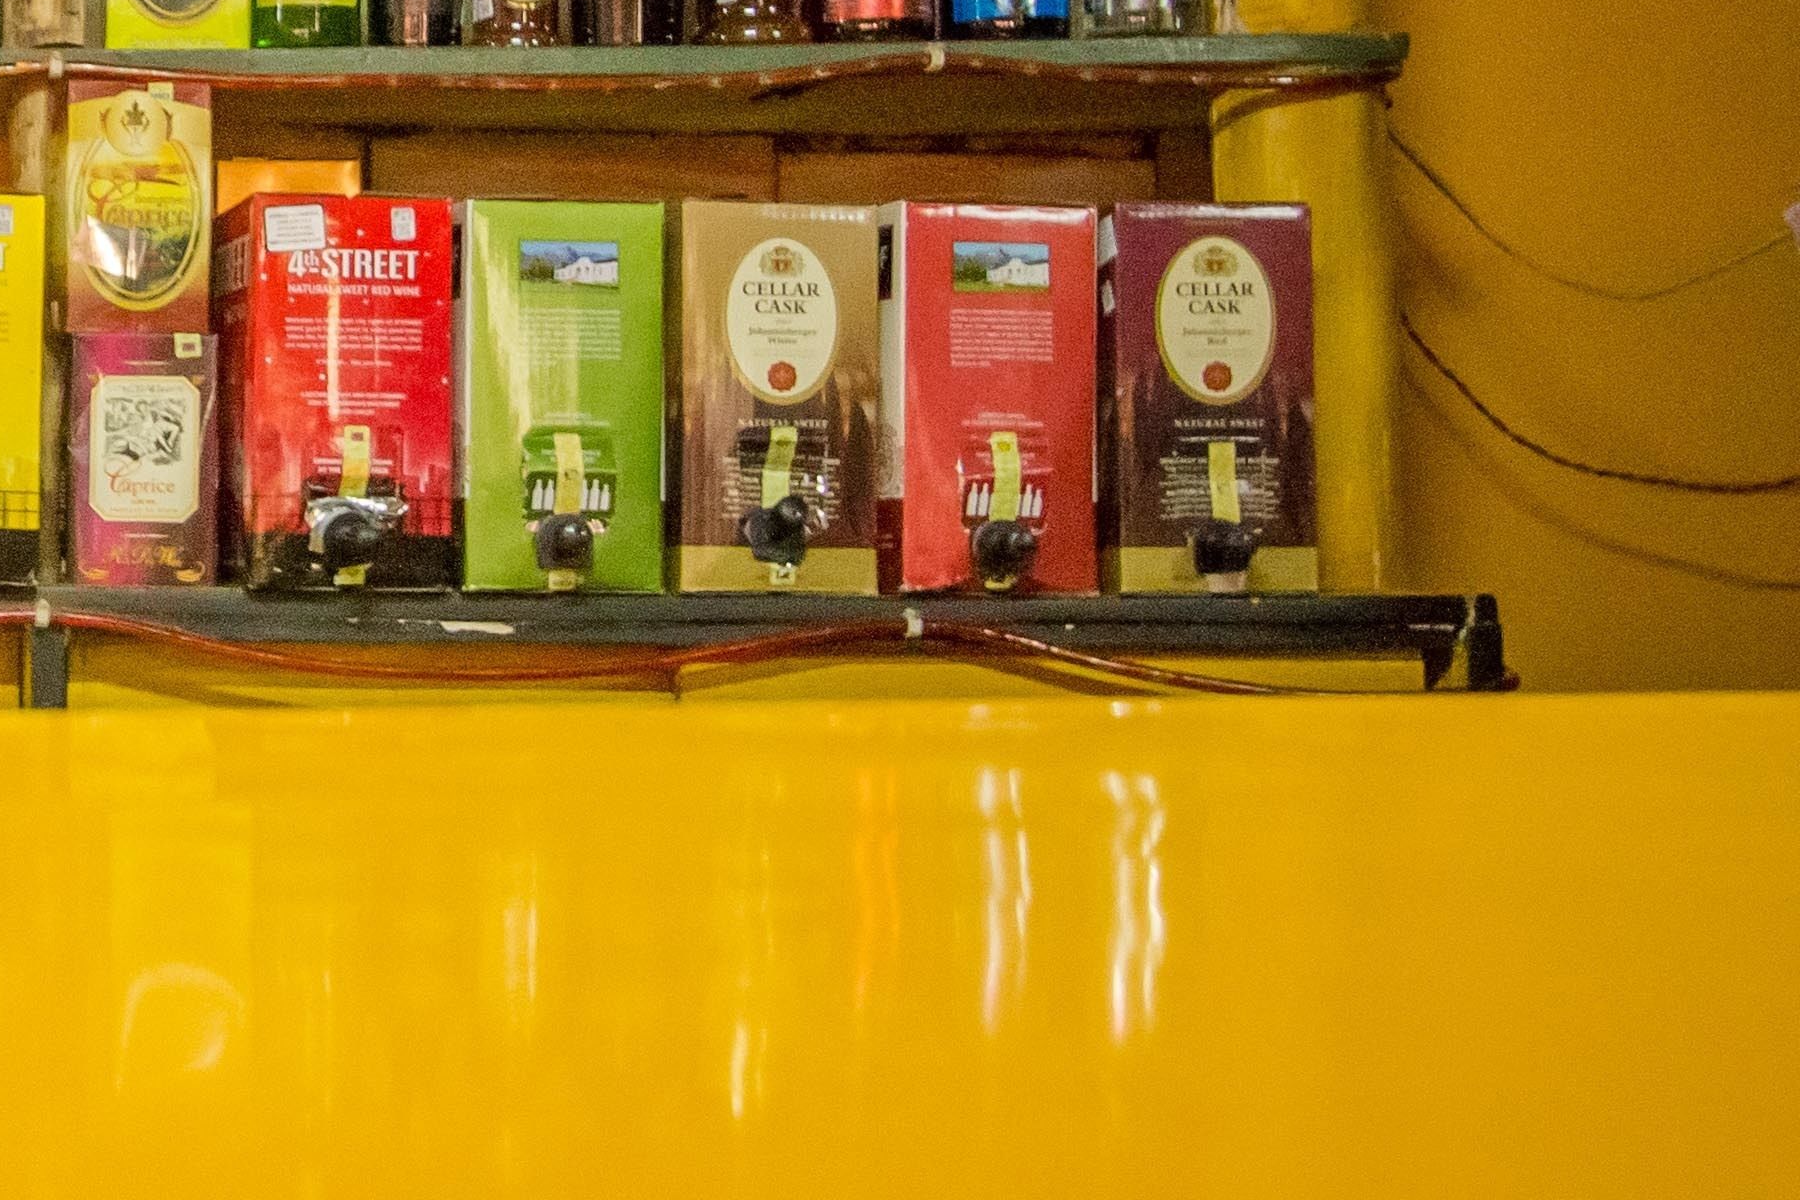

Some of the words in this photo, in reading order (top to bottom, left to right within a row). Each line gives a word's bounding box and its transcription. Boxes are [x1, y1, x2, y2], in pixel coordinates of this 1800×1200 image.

[287, 248, 320, 278] 4th
[320, 248, 419, 281] STREET
[370, 284, 392, 296] RED
[393, 285, 422, 298] WINE
[741, 281, 821, 298] CELLAR
[1176, 281, 1255, 297] CELLAR
[753, 299, 809, 315] CASK
[1187, 299, 1242, 315] CASK
[107, 470, 177, 499] Caprice
